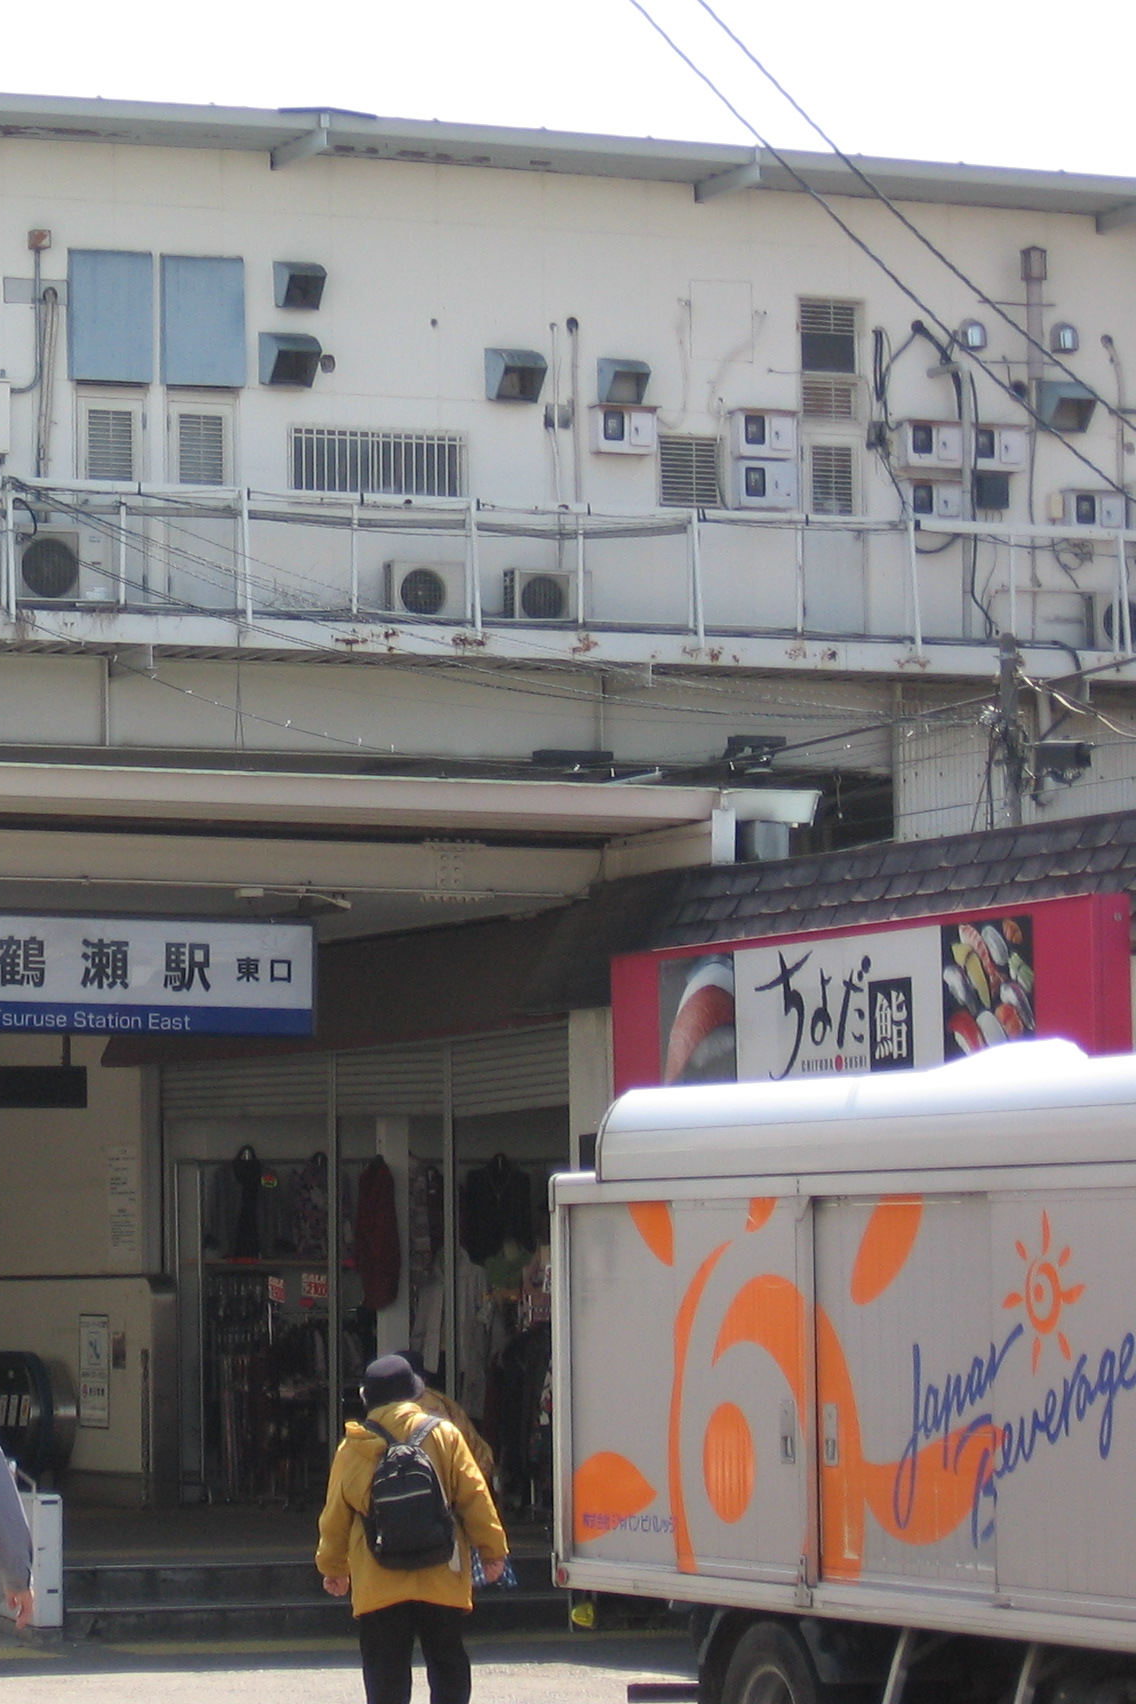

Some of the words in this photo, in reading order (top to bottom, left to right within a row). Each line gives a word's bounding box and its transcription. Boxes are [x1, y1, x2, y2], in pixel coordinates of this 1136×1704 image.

[235, 956, 293, 984] 東口
[73, 1010, 142, 1030] Station
[148, 1013, 192, 1032] East
[754, 950, 872, 1081] ちよだ
[873, 989, 909, 1061] 鮨
